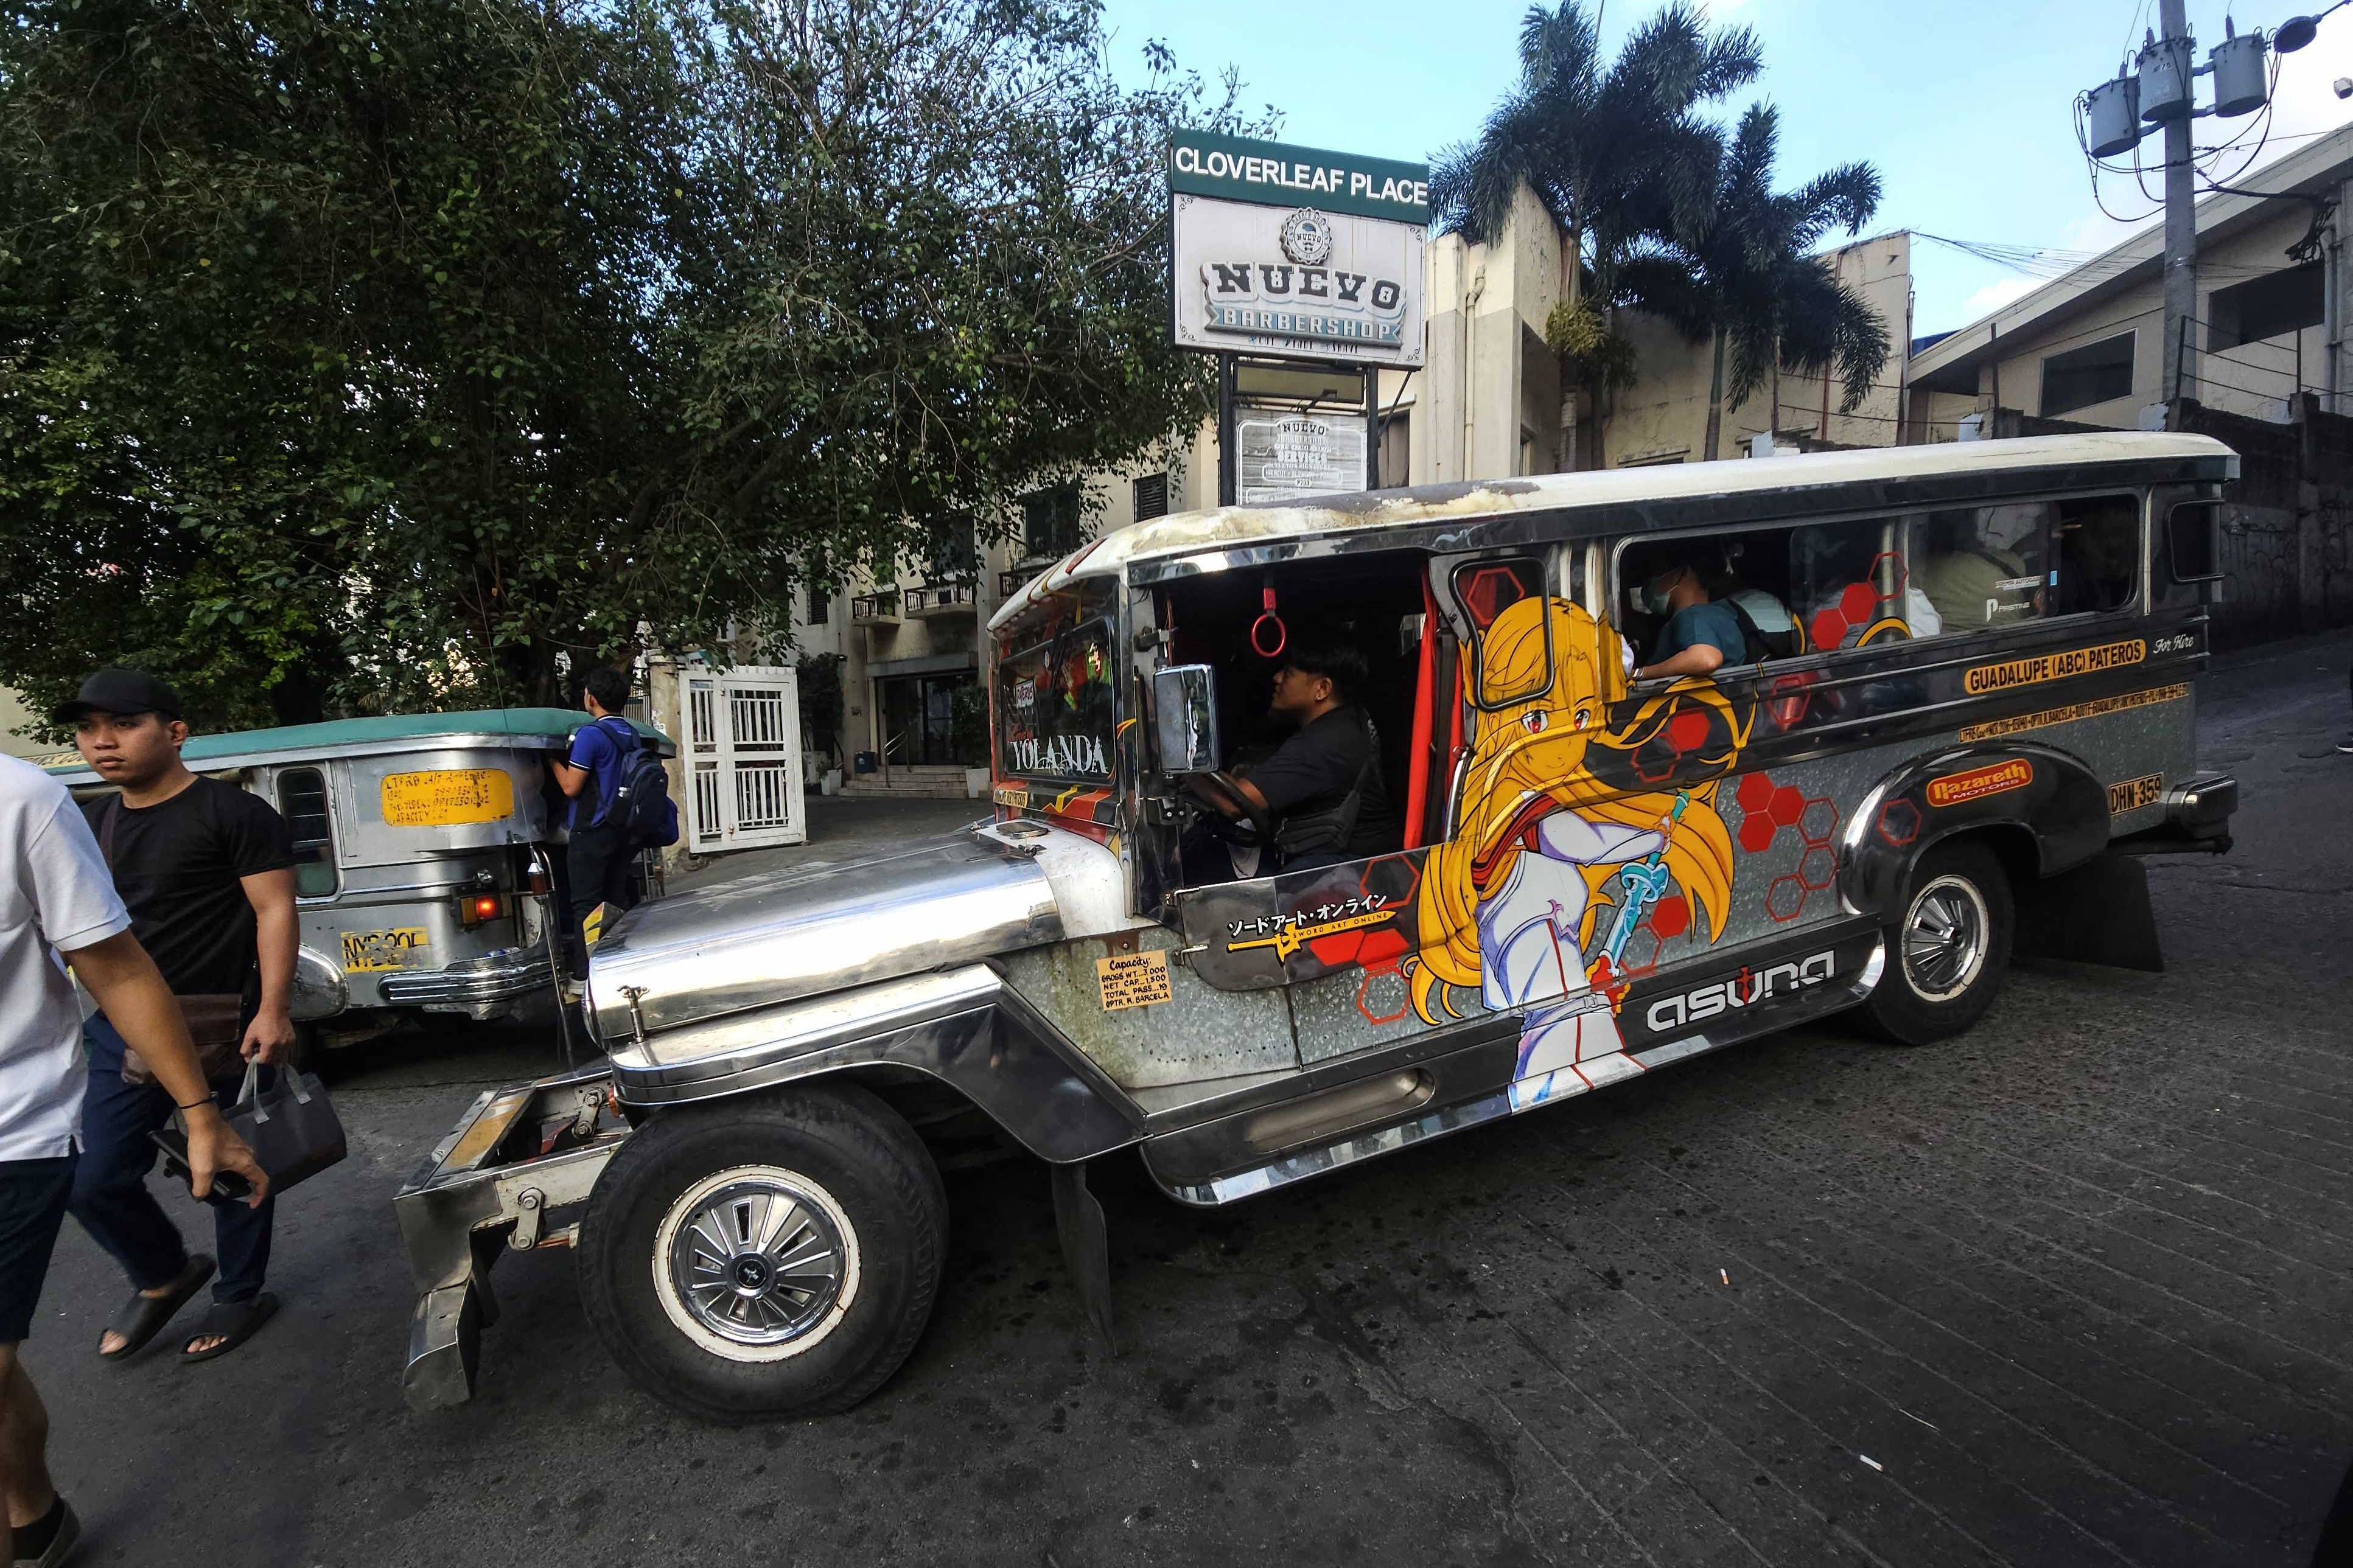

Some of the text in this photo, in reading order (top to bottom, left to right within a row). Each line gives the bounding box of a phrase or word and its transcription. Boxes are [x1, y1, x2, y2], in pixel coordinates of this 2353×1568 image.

[1175, 147, 1428, 206] CLOVERLEAF PLACE
[1296, 233, 1321, 243] NUEVO
[1211, 263, 1401, 310] NUEVO
[1223, 309, 1391, 340] BARBERSHOP
[1282, 422, 1325, 435] NUEVO
[1970, 633, 2194, 691] GUADALUPE (ABC) PATEROS For Hire
[1009, 734, 1110, 774] YOLANDA
[1953, 779, 2019, 800] MOTORS
[1228, 894, 1387, 936] ソードアート・オンライン
[1293, 911, 1388, 939] SWORD ART ONLINE
[1110, 956, 1152, 972] Capacity:
[1101, 972, 1124, 983] GROSS
[1103, 981, 1121, 991] NET
[1105, 989, 1130, 1000] TOTAL
[1106, 998, 1125, 1008] OPTR.
[1136, 992, 1169, 1003] BARCELA
